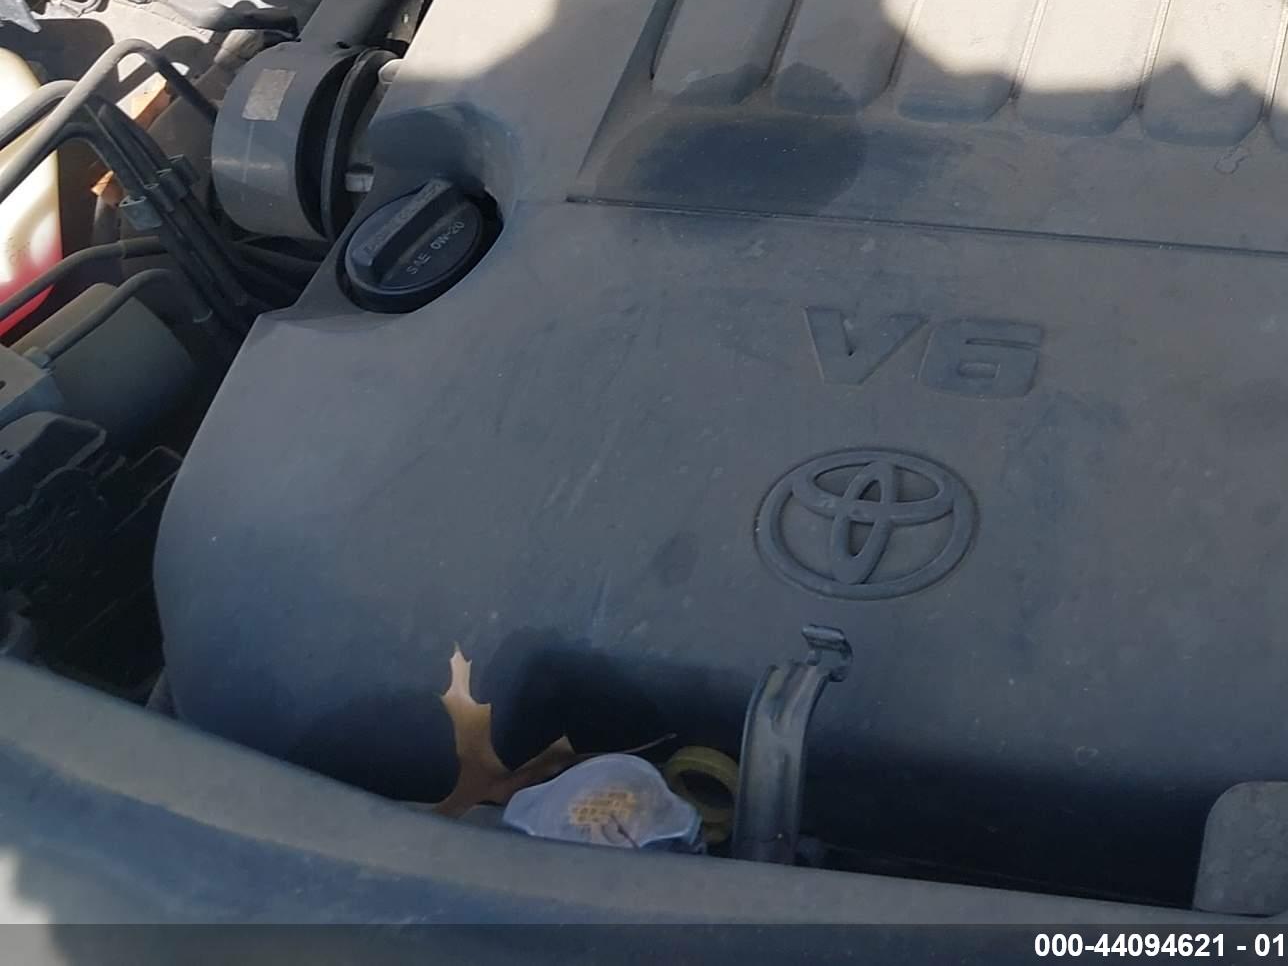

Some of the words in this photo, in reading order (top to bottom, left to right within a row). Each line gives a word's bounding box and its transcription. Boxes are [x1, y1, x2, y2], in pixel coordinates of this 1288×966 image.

[406, 252, 432, 275] SAE
[430, 220, 465, 251] 0W-20
[800, 303, 1047, 402] V6
